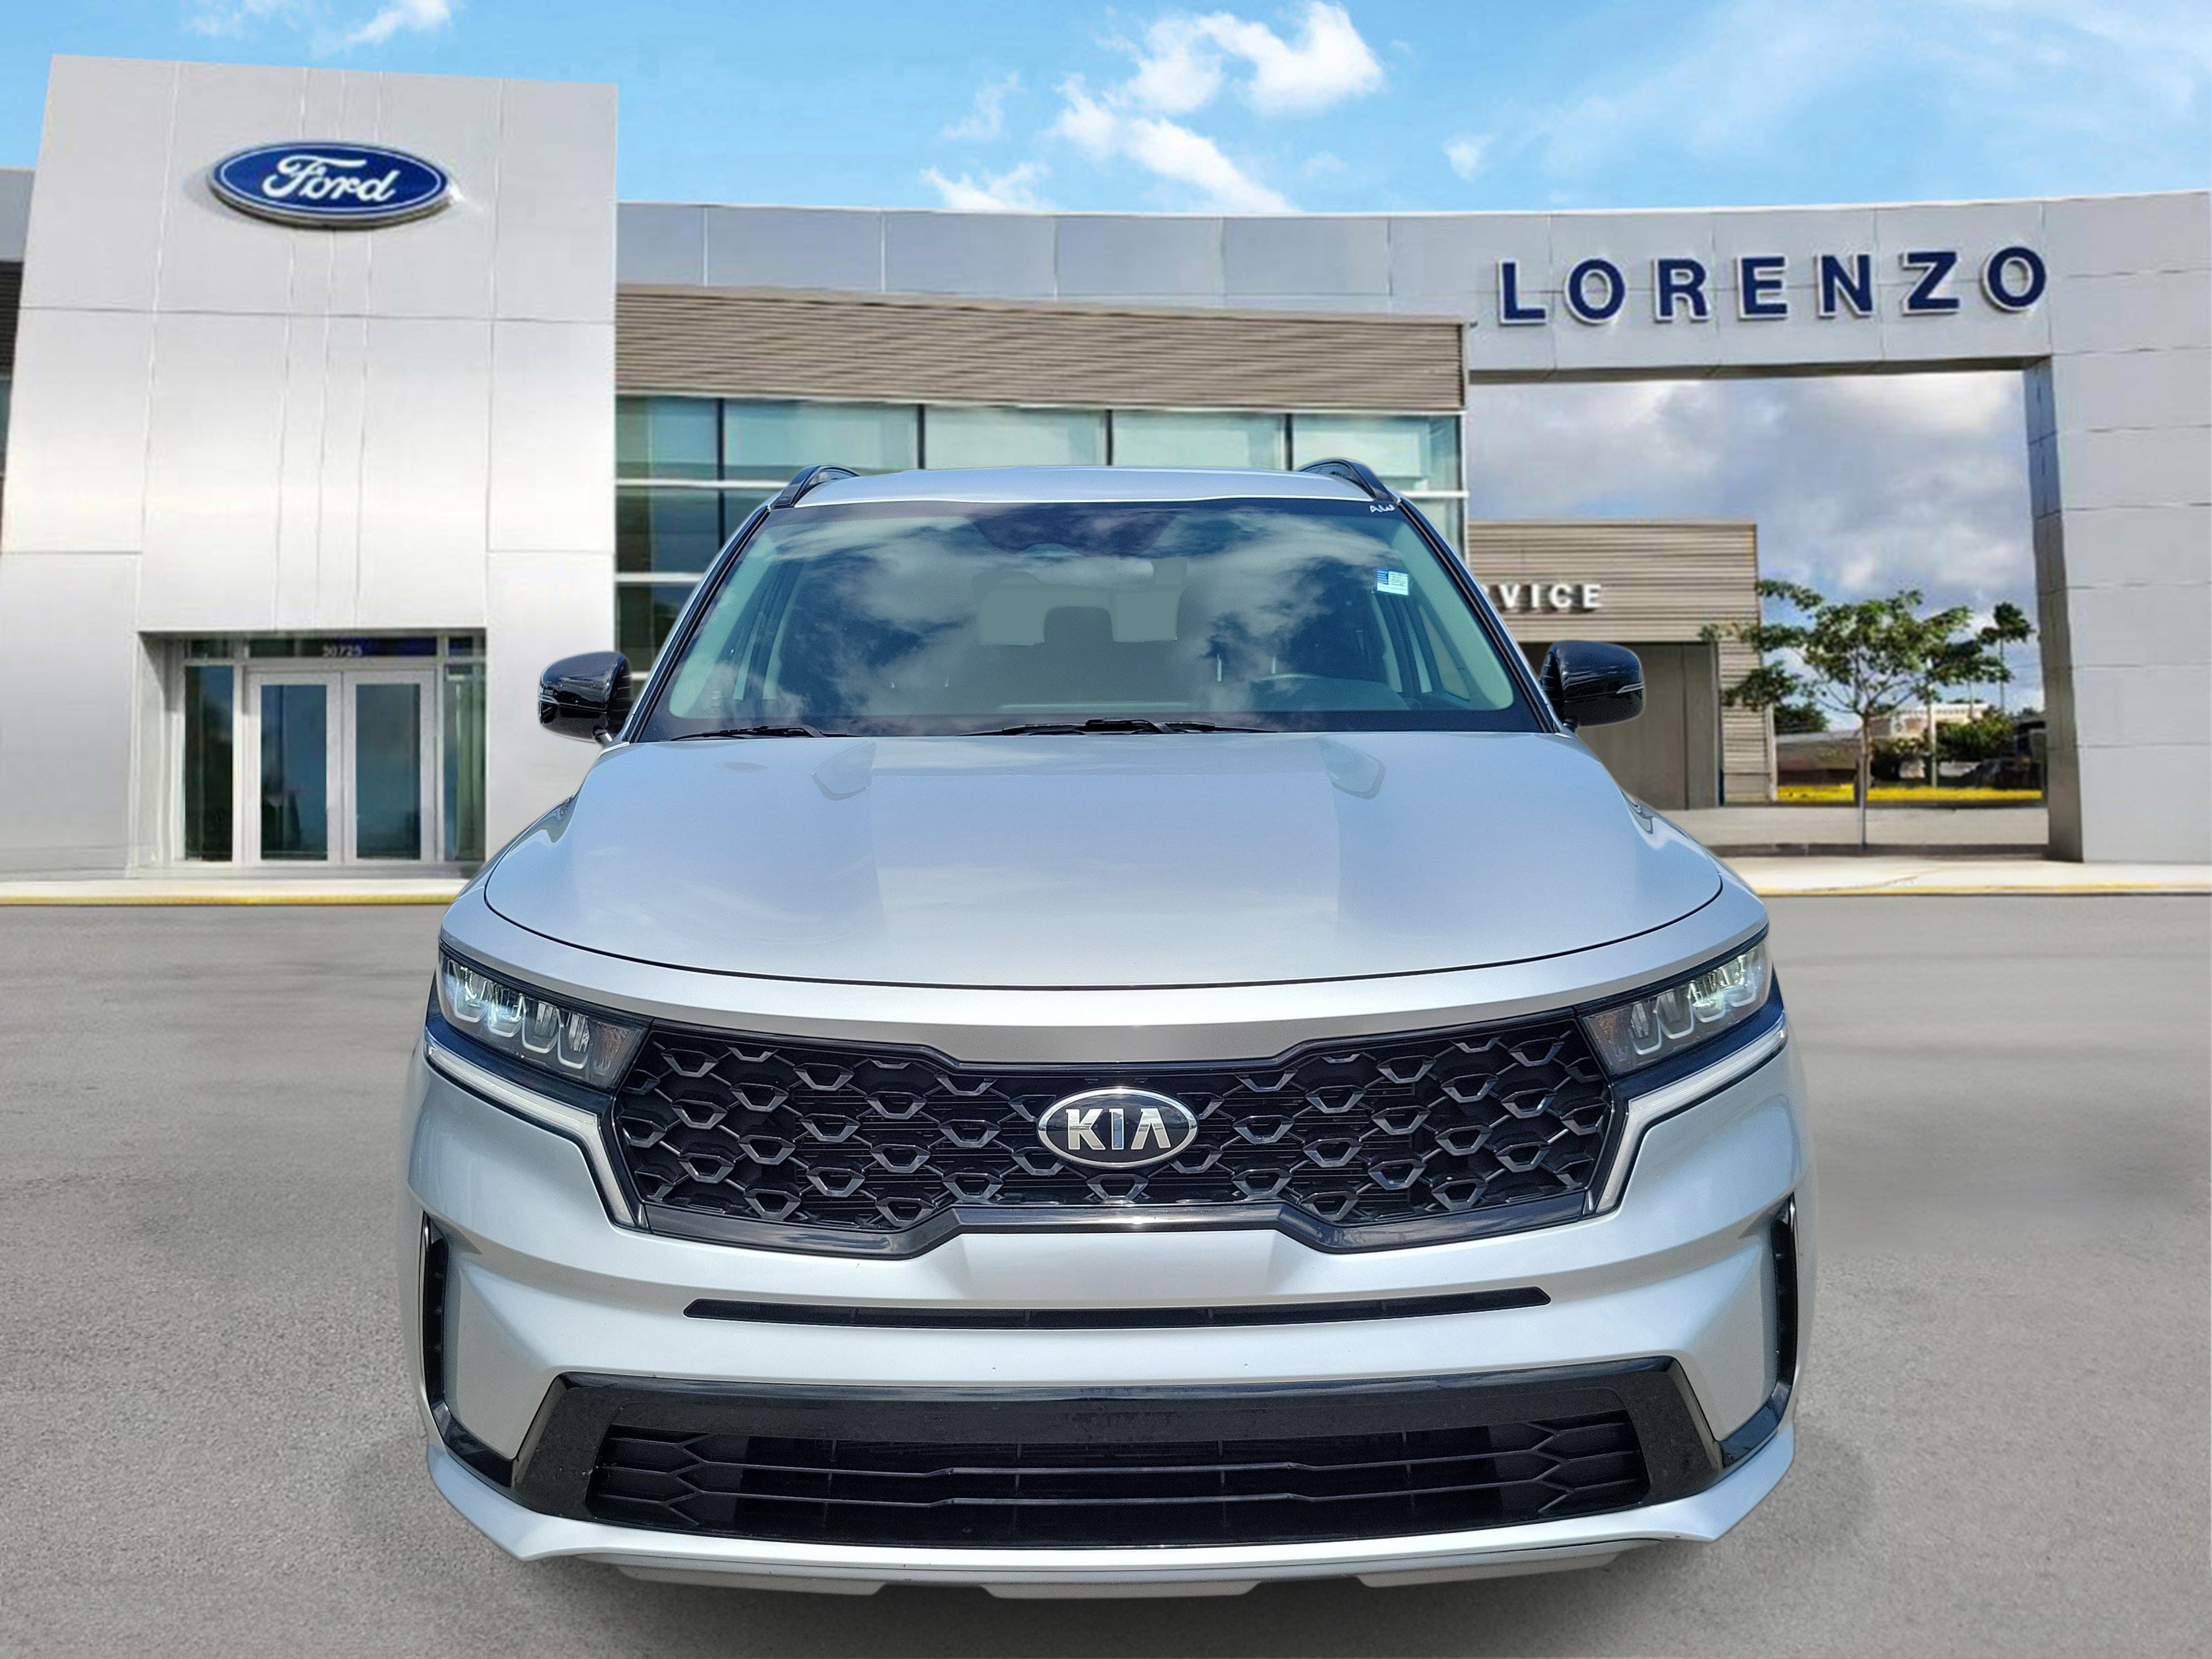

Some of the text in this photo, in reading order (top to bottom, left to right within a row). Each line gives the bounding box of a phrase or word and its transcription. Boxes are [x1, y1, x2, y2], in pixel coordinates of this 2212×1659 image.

[262, 154, 400, 202] Ford
[1497, 246, 2047, 326] LORENZO
[1481, 584, 1602, 609] VICE
[1065, 1108, 1171, 1150] KIA
